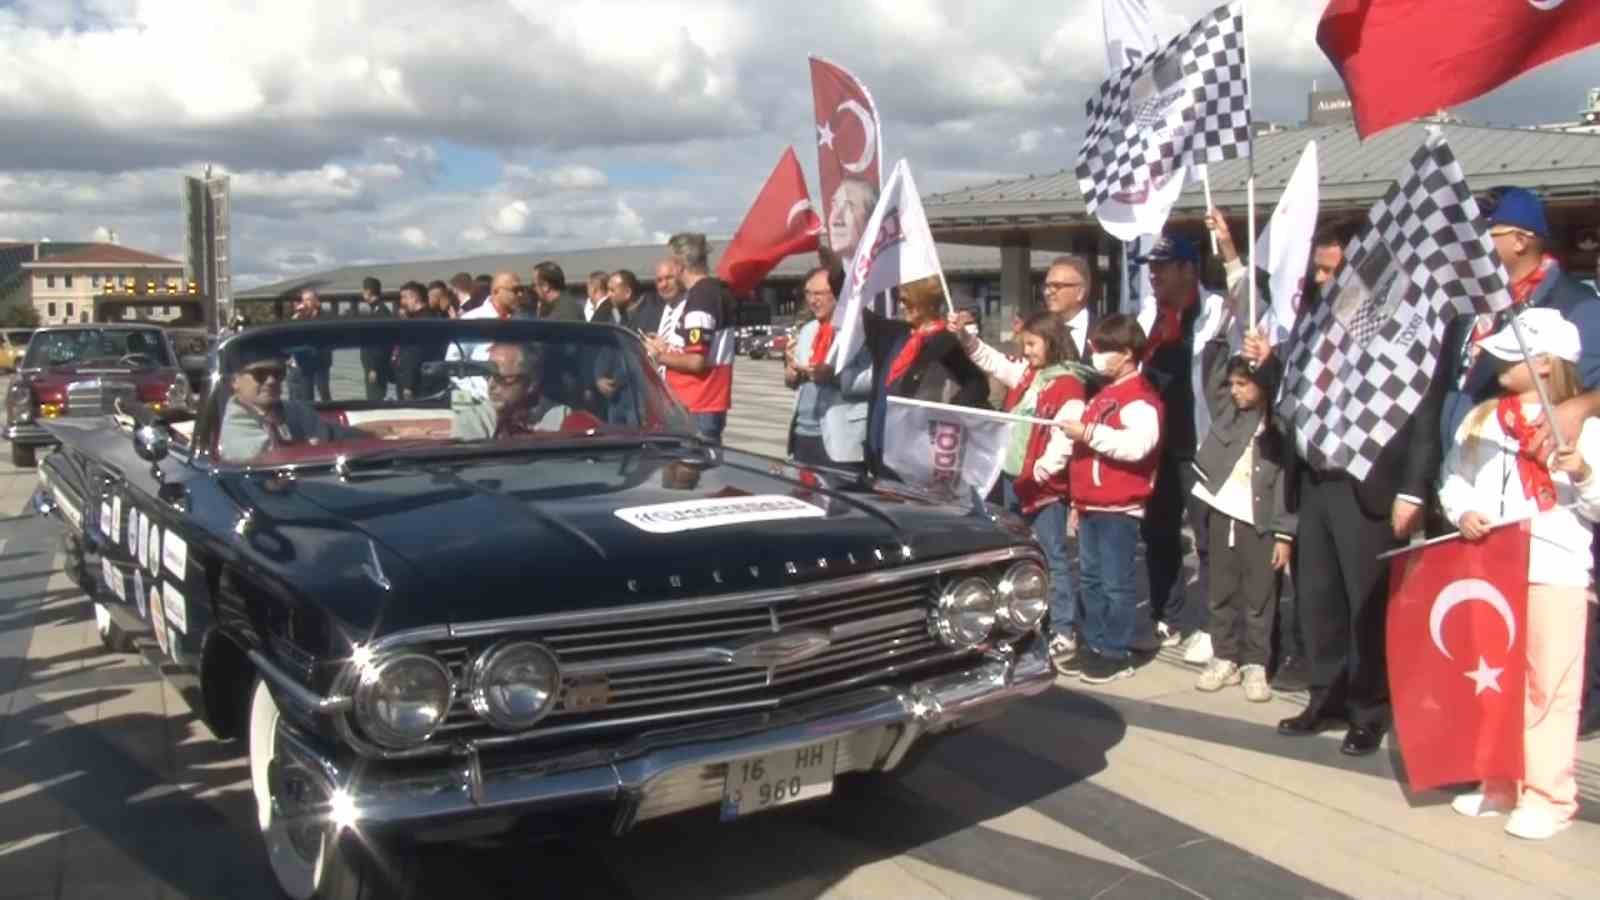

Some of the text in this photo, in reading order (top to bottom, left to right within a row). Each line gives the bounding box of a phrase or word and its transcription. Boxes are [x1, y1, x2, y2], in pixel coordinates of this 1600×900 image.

[740, 743, 824, 784] 16 HH
[759, 776, 801, 804] 960
